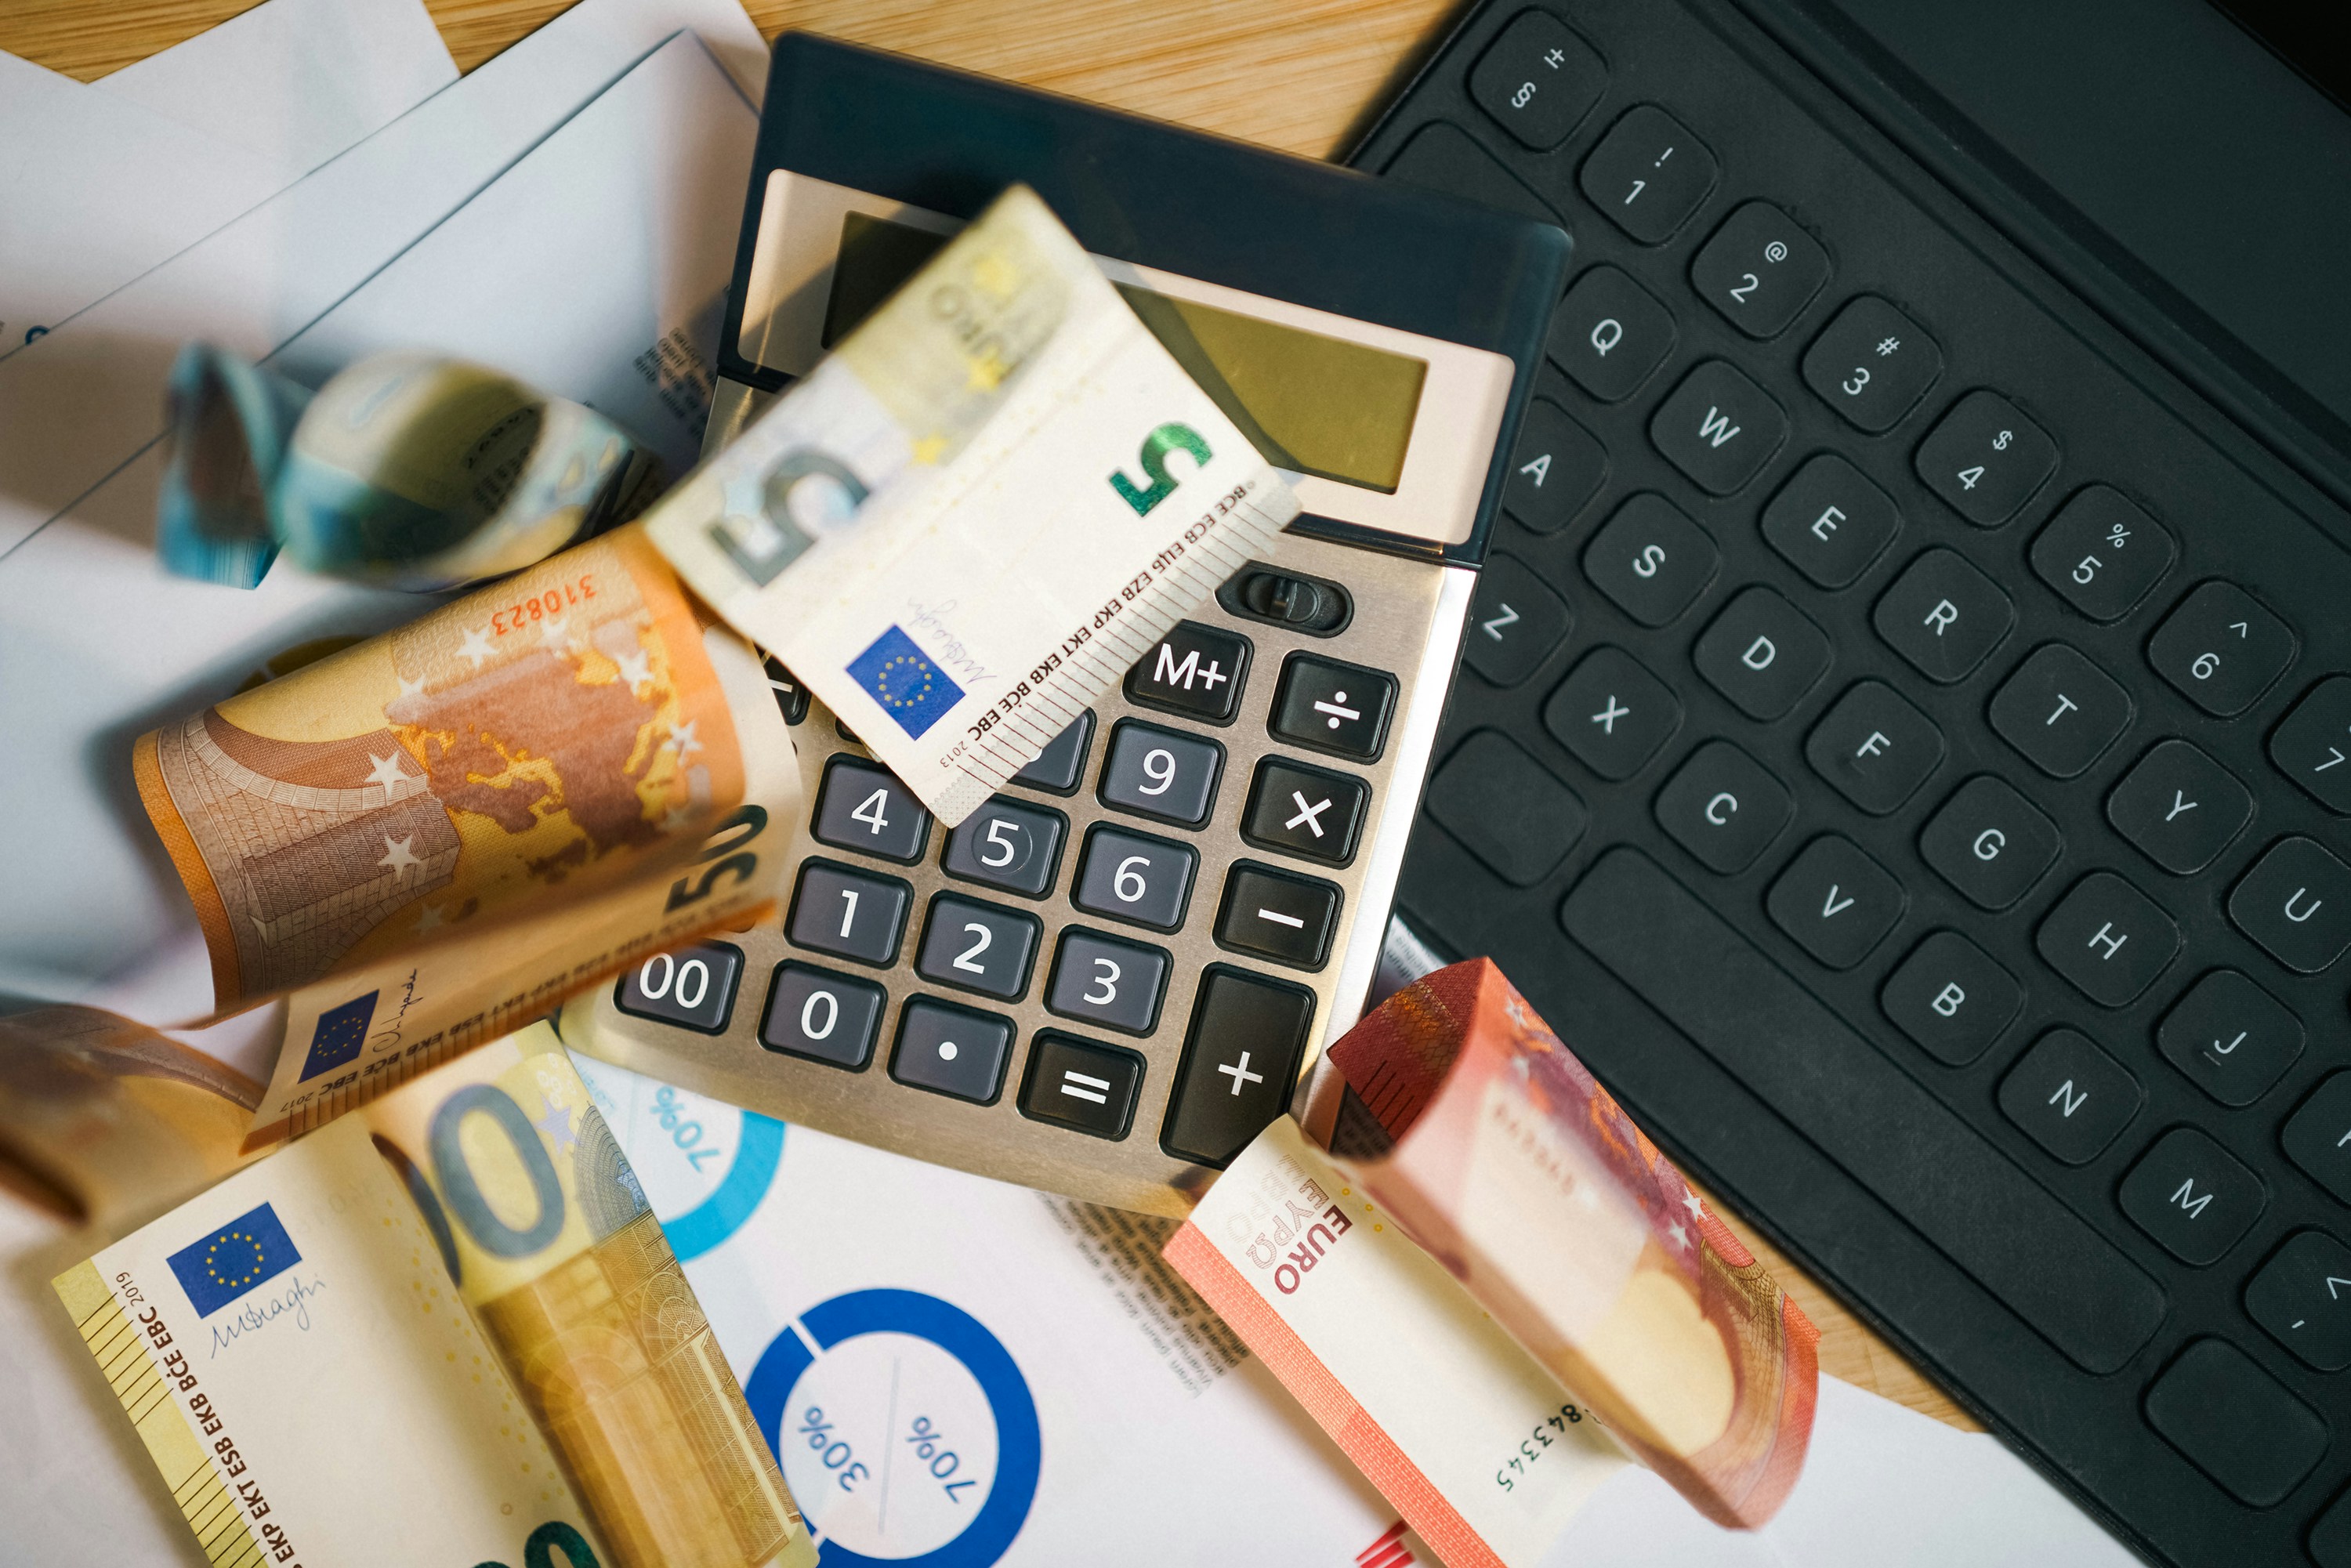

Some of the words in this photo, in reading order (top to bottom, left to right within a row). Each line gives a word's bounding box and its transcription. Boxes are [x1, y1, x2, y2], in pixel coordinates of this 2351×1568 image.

[1625, 181, 1645, 204] 1
[1766, 241, 1787, 263] @
[1730, 273, 1759, 302] 2
[1592, 319, 1622, 356] Q
[1877, 337, 1900, 356] #
[1843, 368, 1870, 395] 3
[1700, 407, 1740, 447] W
[1993, 431, 2012, 450] $
[1107, 422, 1213, 518] 5
[1520, 454, 1551, 487] A
[1958, 466, 1984, 490] 4
[708, 447, 869, 586] 5
[1219, 486, 1246, 515] BCE
[1184, 514, 1215, 544] ECB
[1812, 506, 1846, 541] E
[2106, 524, 2131, 548] %
[1634, 545, 1665, 577] S
[2073, 556, 2102, 584] 5
[1121, 571, 1152, 600] EZB
[490, 574, 598, 636] 310823
[1093, 599, 1122, 628] EKP
[1483, 603, 1519, 639] Z
[1925, 599, 1958, 636] R
[1061, 626, 1092, 657] EKT
[1743, 636, 1775, 669] D
[1030, 653, 1062, 684] EKB
[1154, 643, 1227, 693] M+
[2192, 653, 2219, 679] 6
[967, 708, 1001, 741] EBC
[1593, 696, 1629, 733] X
[2047, 694, 2078, 725] T
[940, 741, 967, 767] 2013
[1857, 732, 1890, 756] F
[2315, 748, 2345, 771] 7
[1139, 749, 1176, 795] 9
[852, 789, 888, 834] 4
[1707, 793, 1737, 824] C
[2166, 790, 2197, 820] Y
[664, 804, 768, 914] 50
[982, 820, 1016, 868] 5
[1974, 829, 2005, 860] G
[1114, 856, 1150, 902] 6
[840, 890, 858, 937] 1
[1824, 885, 1854, 917] V
[2285, 888, 2321, 922] U
[953, 923, 991, 974] 2
[2088, 922, 2127, 959] H
[640, 954, 708, 1008] 00
[1084, 958, 1120, 1005] 3
[802, 990, 839, 1040] 0
[1933, 983, 1965, 1016] B
[449, 1012, 485, 1036] ESB
[405, 1030, 444, 1057] EKB
[2215, 1032, 2247, 1053] J
[318, 1070, 359, 1096] EBC
[2049, 1080, 2088, 1117] N
[280, 1092, 314, 1114] 2017
[650, 1085, 720, 1173] 70%
[2171, 1179, 2213, 1219] M
[1274, 1204, 1354, 1295] EURO
[115, 1271, 145, 1307] 2019
[138, 1305, 173, 1349] EBC
[189, 1392, 223, 1436] EKB
[214, 1436, 248, 1478] ESB
[799, 1405, 871, 1494] 30%
[904, 1414, 980, 1505] 70%
[1497, 1403, 1583, 1492] 843345
[236, 1479, 270, 1519] EKT
[261, 1522, 295, 1564] EKP
